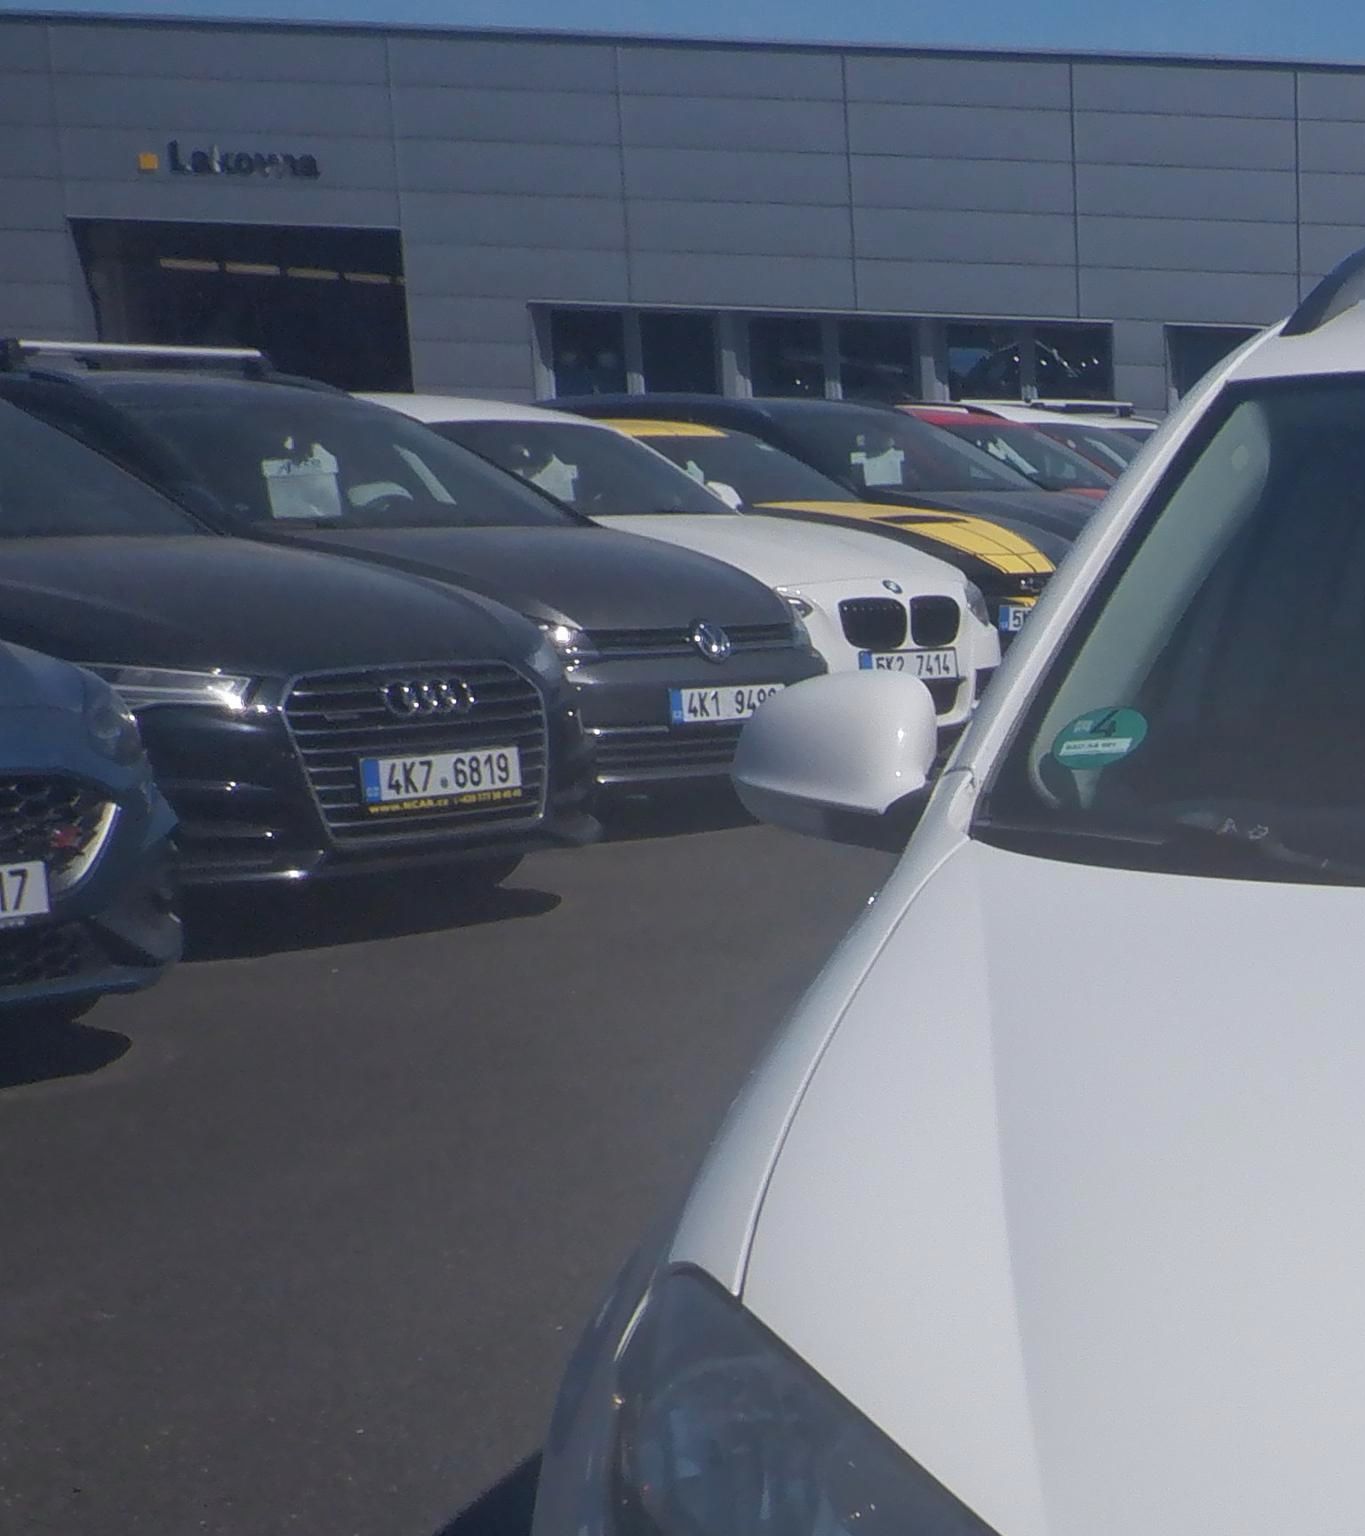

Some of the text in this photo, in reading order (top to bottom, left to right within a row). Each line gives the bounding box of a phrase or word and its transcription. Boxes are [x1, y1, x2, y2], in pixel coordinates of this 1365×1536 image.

[915, 653, 950, 676] 7414
[687, 691, 720, 717] 4K1
[387, 752, 510, 795] 4K7 6819
